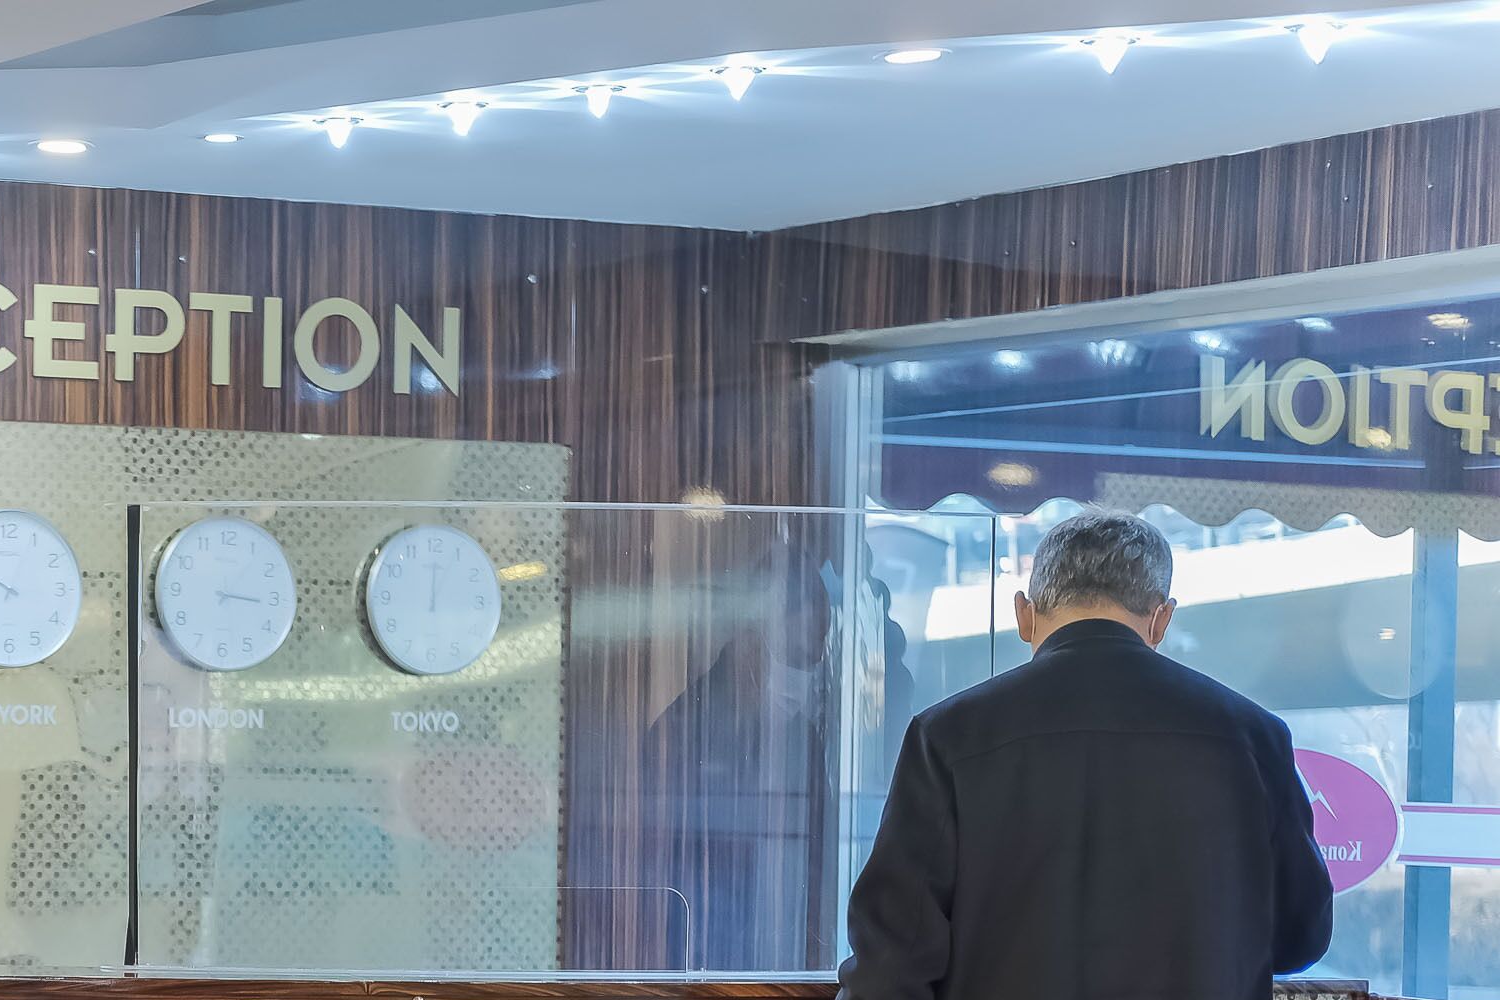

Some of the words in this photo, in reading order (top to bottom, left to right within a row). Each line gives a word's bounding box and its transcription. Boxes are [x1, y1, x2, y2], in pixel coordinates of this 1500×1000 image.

[0, 524, 18, 539] 12
[32, 533, 37, 547] 1
[48, 554, 59, 568] 2
[55, 582, 66, 597] 3
[49, 611, 59, 624] 4
[4, 638, 14, 653] 6
[29, 631, 41, 646] 5
[168, 707, 265, 729] LONDON
[391, 711, 460, 733] TOKYO
